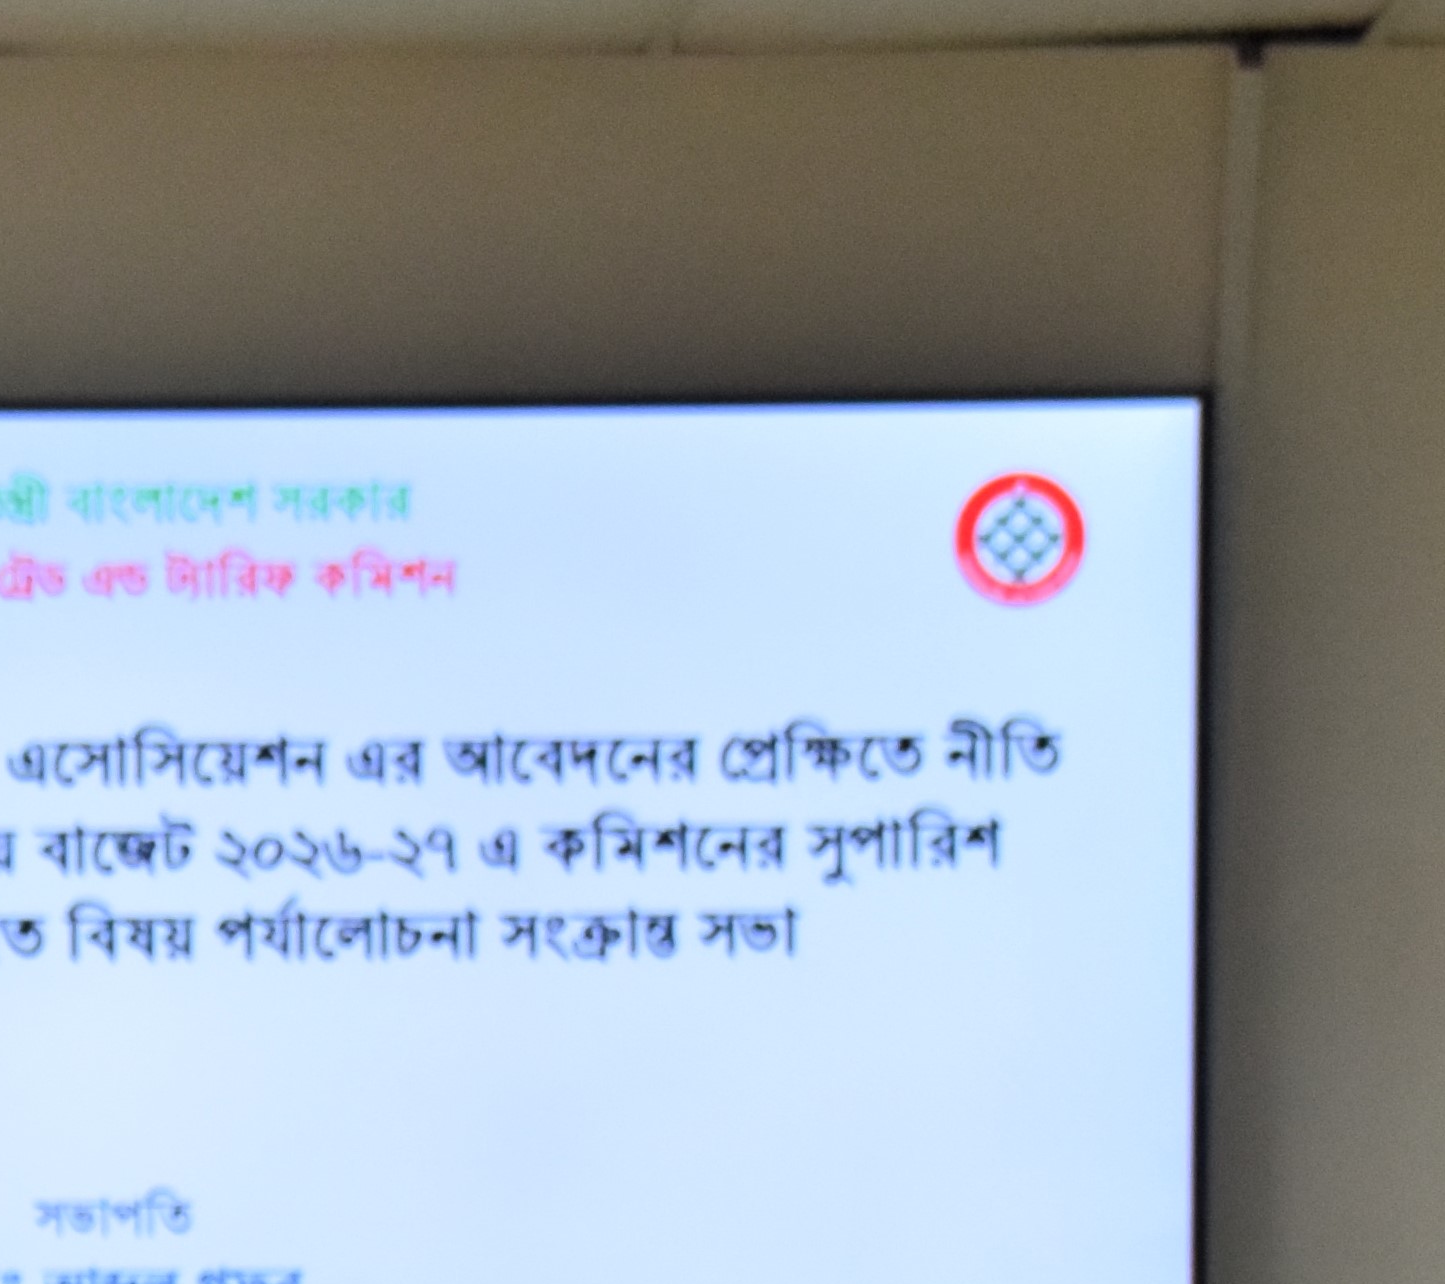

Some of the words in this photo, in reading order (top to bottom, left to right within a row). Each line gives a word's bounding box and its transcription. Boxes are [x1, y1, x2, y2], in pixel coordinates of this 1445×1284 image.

[66, 480, 259, 524] বাংলাদেশ
[273, 480, 413, 522] সরকার
[164, 548, 297, 599] ট্যারিফ
[314, 547, 458, 598] কমিশন
[8, 725, 328, 788] এসোসিয়েশন
[345, 739, 426, 786] এর
[442, 732, 701, 785] আবেদনের
[719, 719, 926, 785] প্রেক্ষিতে
[945, 717, 1063, 778] নীতি
[38, 812, 197, 877] বাজেট
[215, 825, 458, 880] ২০২৬-২৭
[478, 827, 521, 873] এ
[541, 809, 788, 873] কমিশনের
[807, 806, 1004, 886] সুপারিশ
[65, 901, 198, 961] বিষয়
[216, 896, 482, 962] পর্যালোচনা
[499, 906, 680, 962] সংক্রান্ত
[698, 906, 801, 957] সভা
[33, 1186, 194, 1237] সভাপতি
